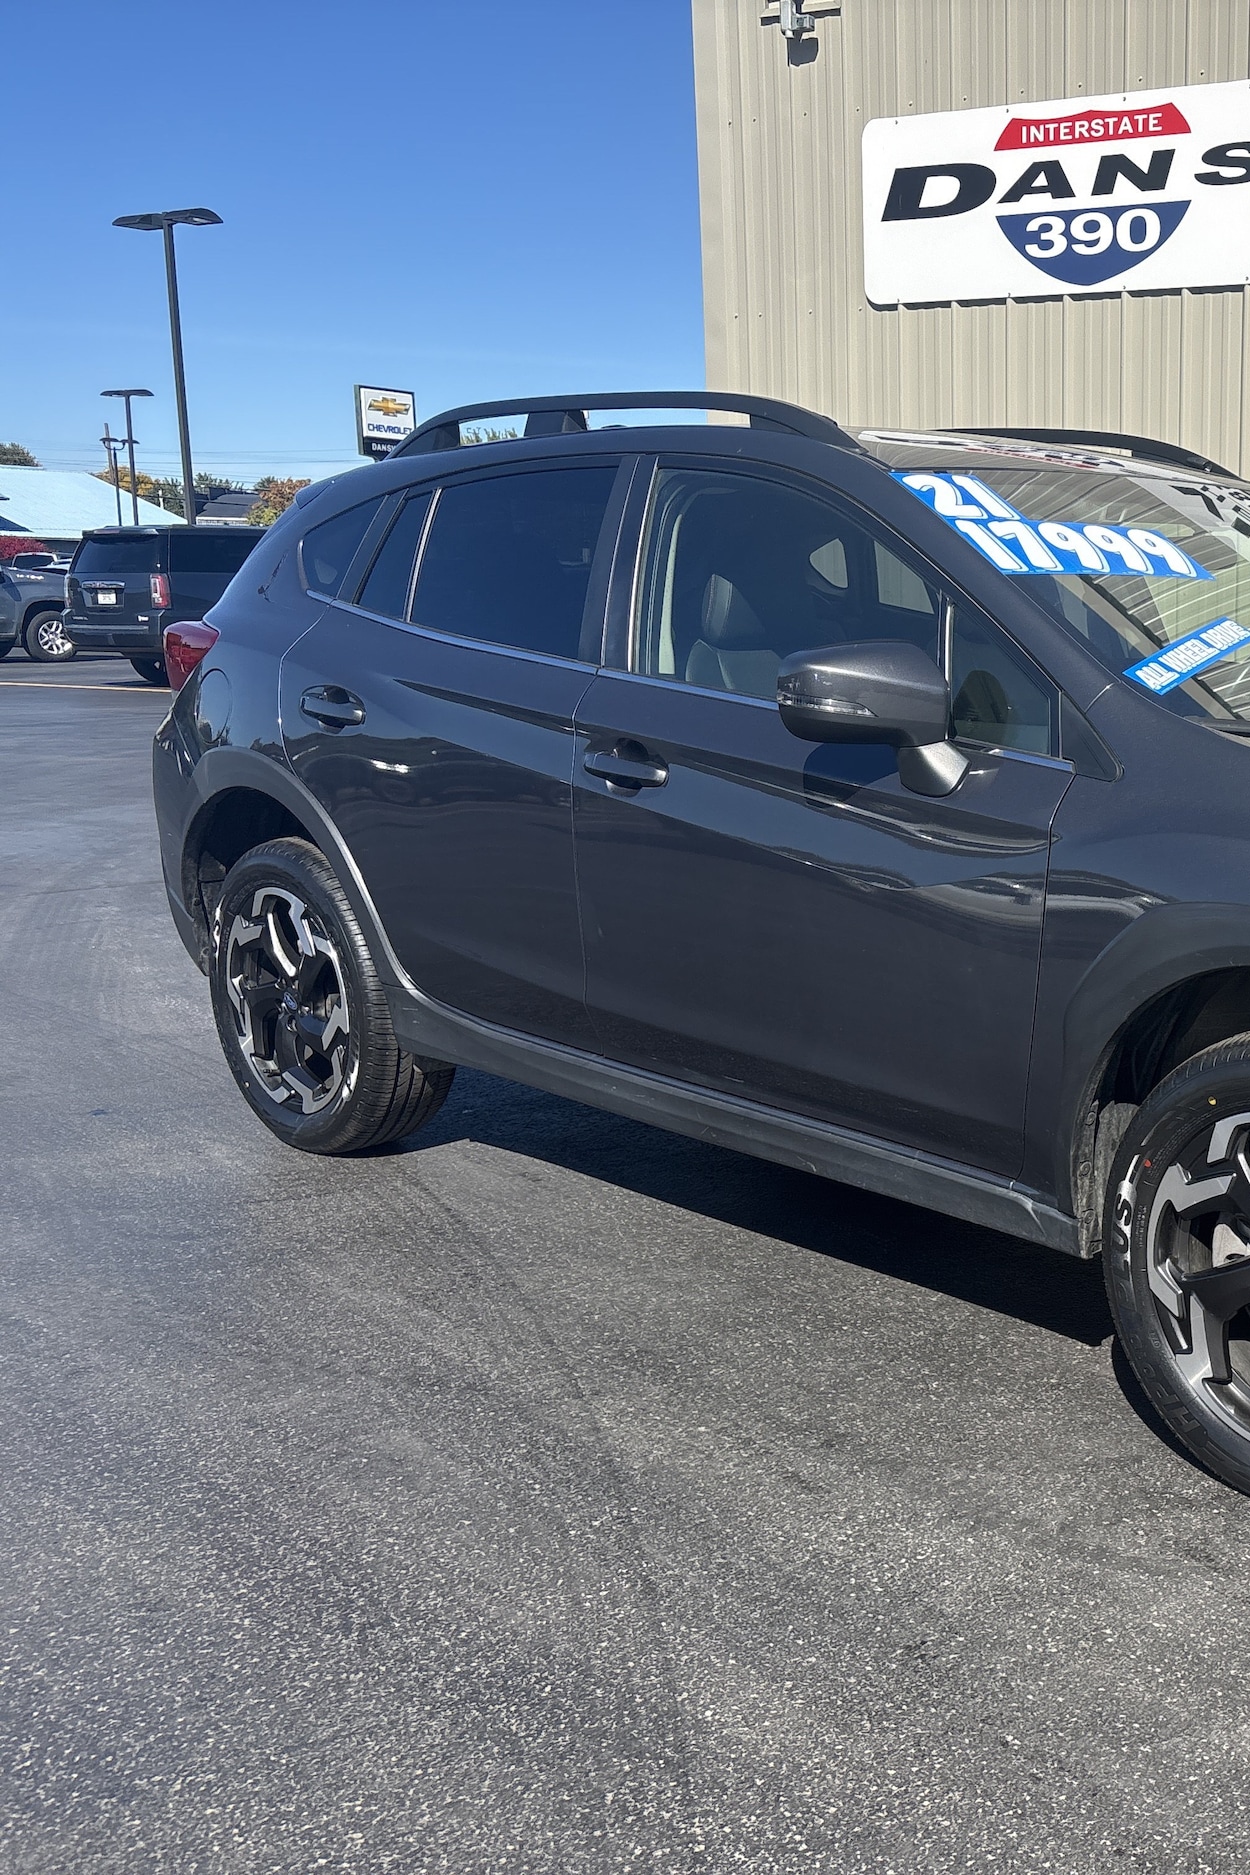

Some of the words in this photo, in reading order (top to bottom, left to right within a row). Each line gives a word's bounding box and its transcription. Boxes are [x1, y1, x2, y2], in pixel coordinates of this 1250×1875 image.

[1021, 112, 1163, 144] INTERSTATE
[1024, 208, 1161, 259] 390
[367, 423, 412, 436] CHEVROLET
[902, 473, 1020, 520] 21
[954, 518, 1197, 579] 17999
[1135, 661, 1181, 691] ALL
[1158, 638, 1221, 674] WHEEL
